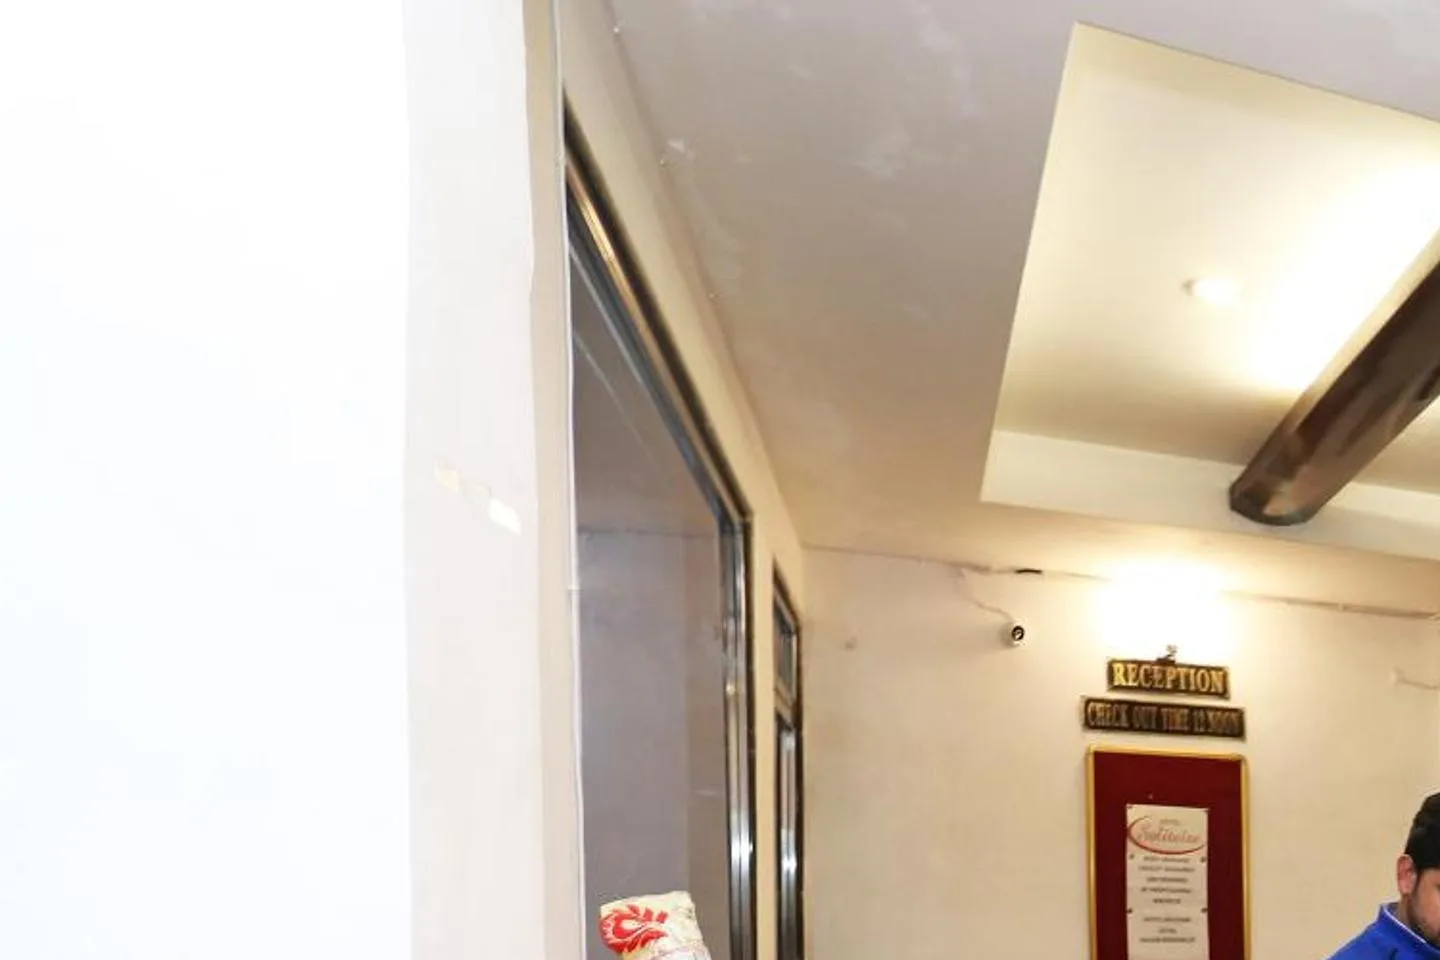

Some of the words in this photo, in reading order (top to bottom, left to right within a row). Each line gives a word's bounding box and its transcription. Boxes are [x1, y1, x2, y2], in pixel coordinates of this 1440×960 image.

[1112, 662, 1224, 692] RECEPTION
[1087, 701, 1128, 728] CHECK
[1132, 705, 1158, 730] OUT
[1161, 707, 1190, 732] TIME
